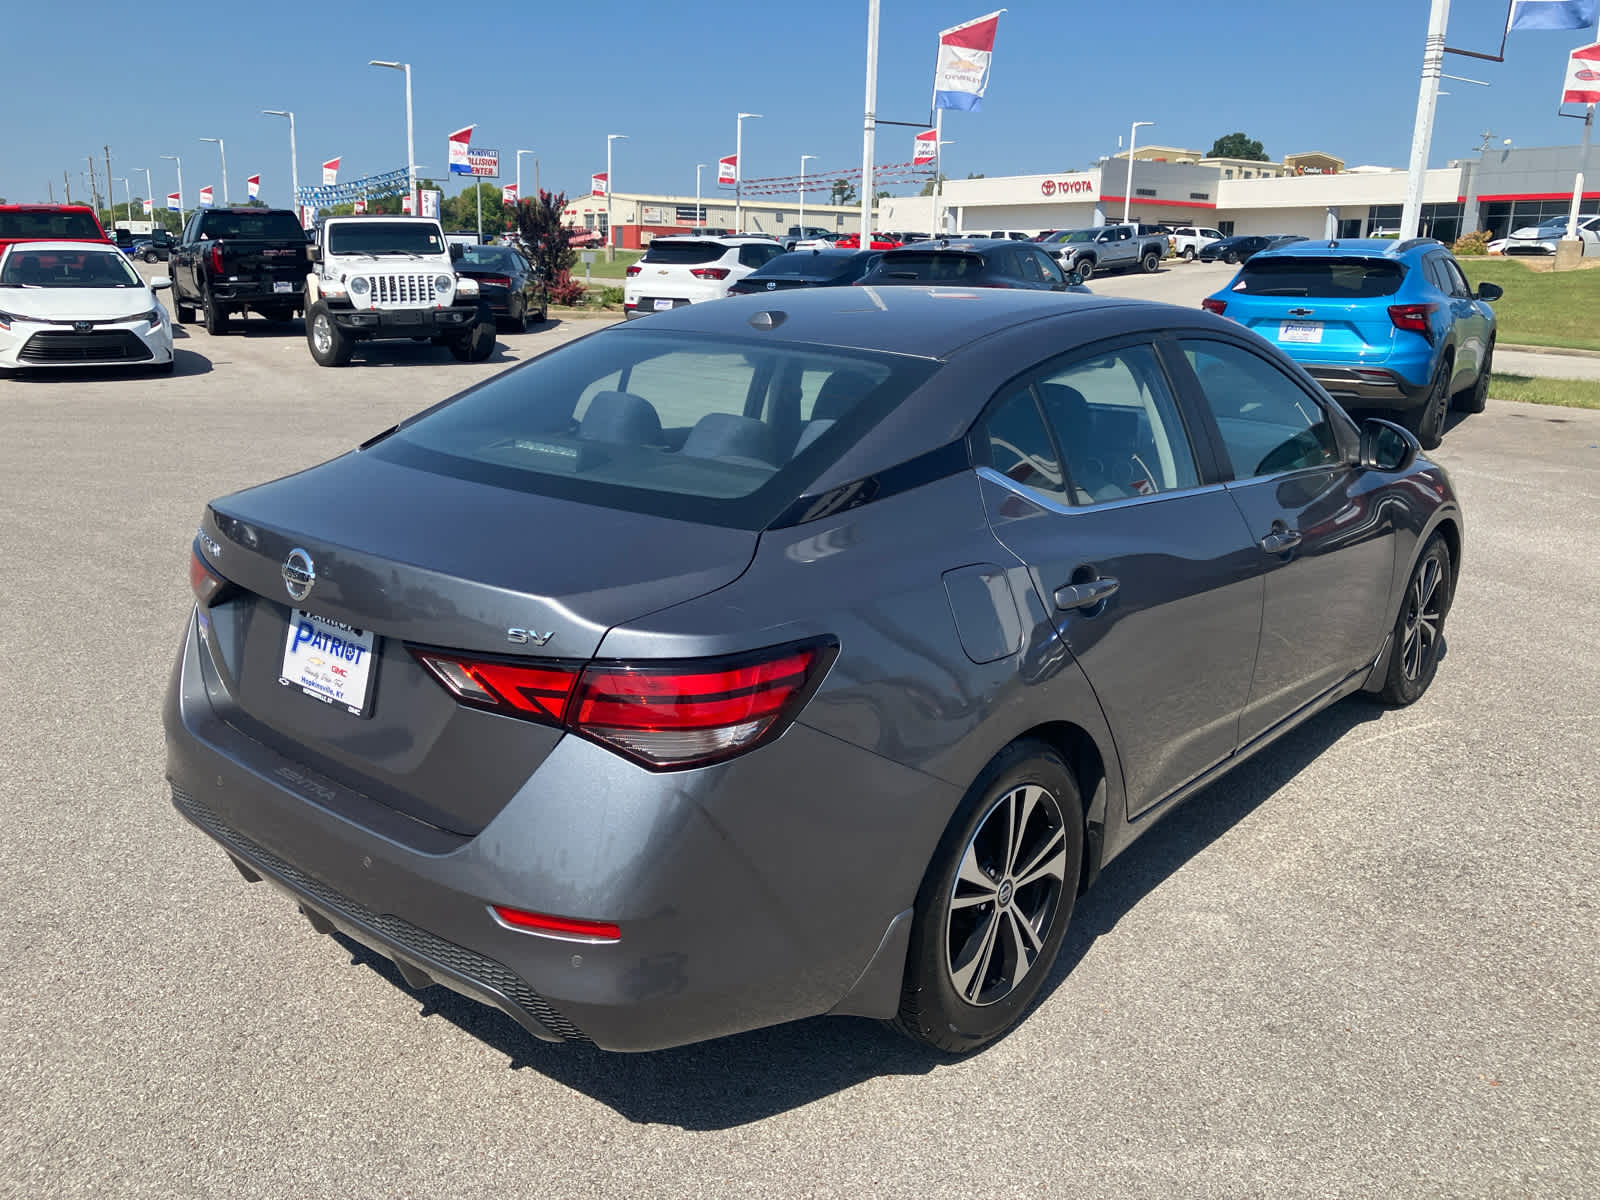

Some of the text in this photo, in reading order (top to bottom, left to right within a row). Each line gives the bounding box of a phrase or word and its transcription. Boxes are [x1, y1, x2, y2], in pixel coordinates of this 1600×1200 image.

[1057, 180, 1093, 193] TOYOTA
[291, 621, 366, 664] PATRIOT
[507, 627, 555, 646] SV
[335, 689, 344, 699] KY
